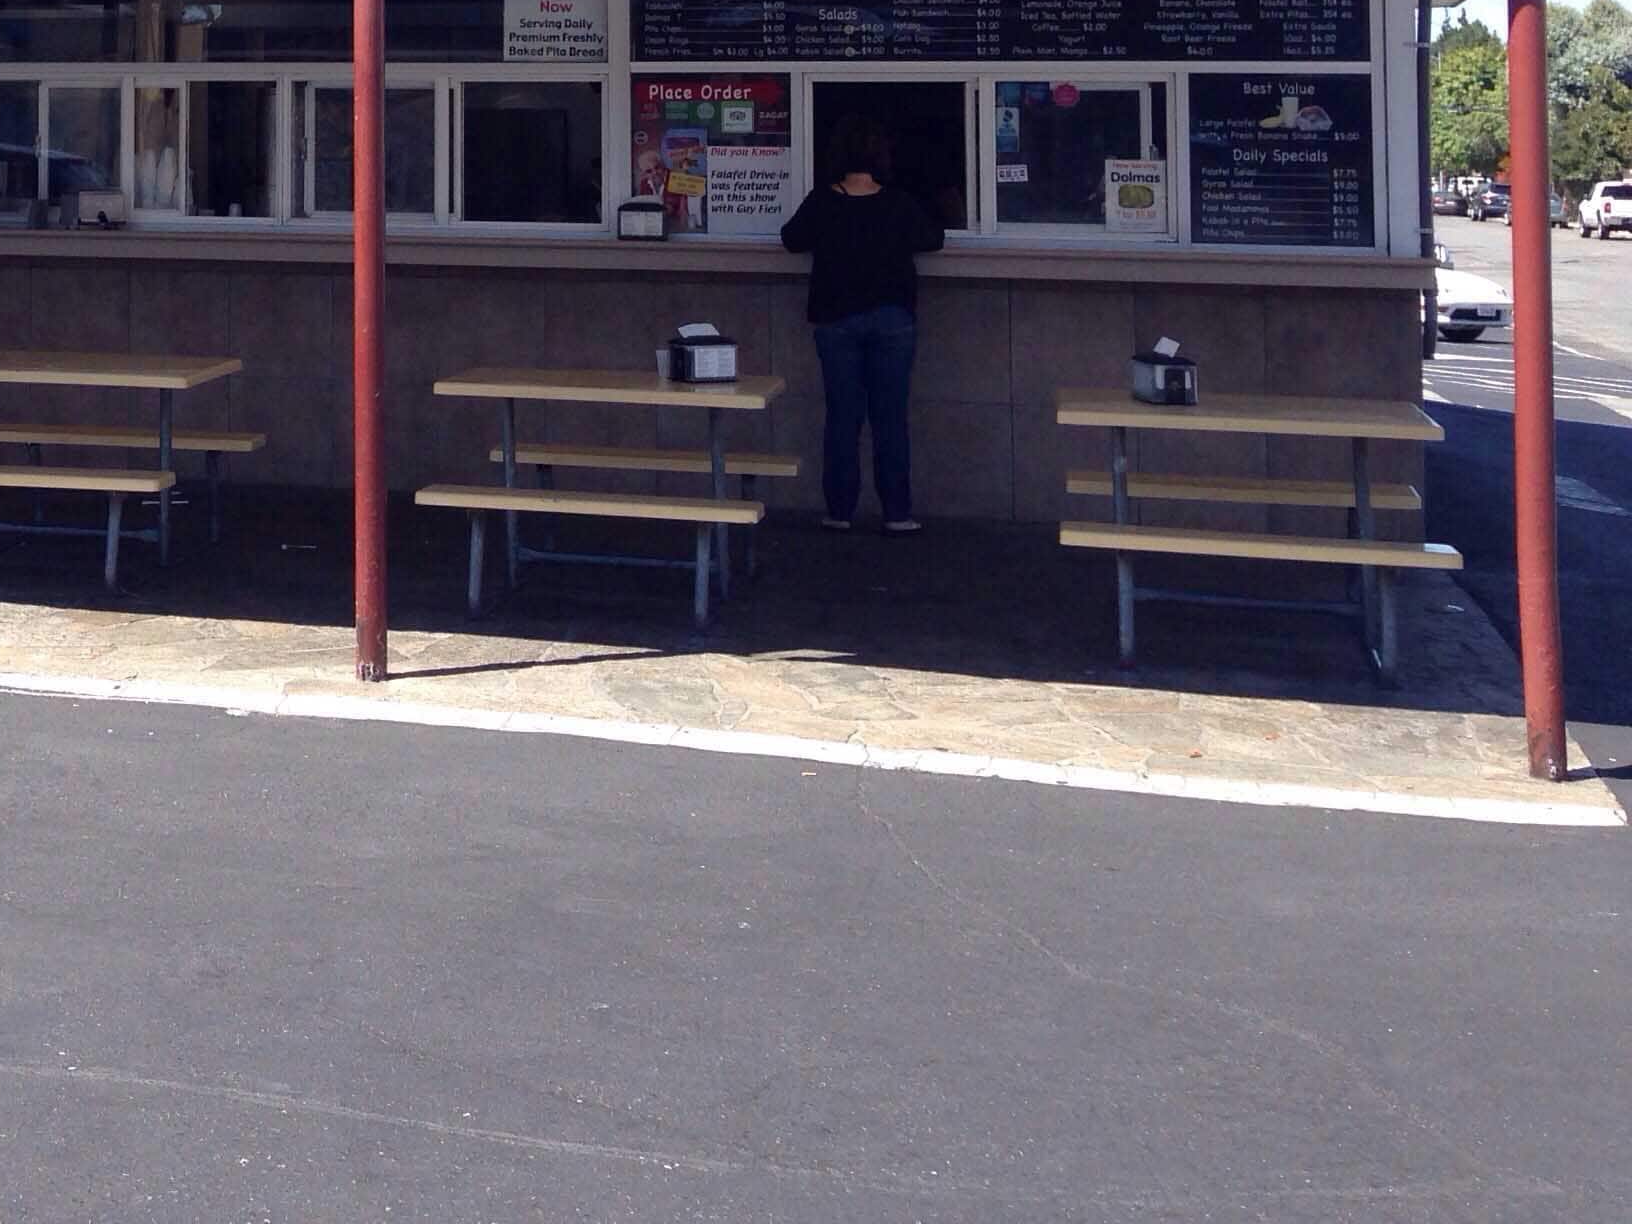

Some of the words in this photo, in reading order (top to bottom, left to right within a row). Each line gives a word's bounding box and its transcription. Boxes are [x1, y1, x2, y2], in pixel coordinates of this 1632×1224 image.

[540, 0, 573, 14] Now
[818, 7, 858, 21] Salads
[519, 18, 562, 31] Serving
[564, 18, 593, 31] Daily
[509, 32, 559, 44] Premium
[562, 32, 604, 46] Freshly
[509, 45, 543, 57] Baked
[546, 45, 567, 57] Pita
[569, 45, 604, 57] Bread
[648, 84, 693, 100] Place
[700, 84, 752, 100] Order
[1243, 81, 1273, 95] Best
[1278, 82, 1316, 96] Value
[711, 147, 728, 156] Did
[730, 148, 749, 158] you
[1233, 148, 1267, 165] Daily
[1272, 148, 1329, 166] Specials
[711, 169, 747, 180] Falafel
[1111, 171, 1161, 183] Dolmas
[711, 182, 731, 191] was
[734, 181, 781, 192] featured
[727, 193, 746, 202] this
[749, 193, 777, 202] show
[711, 204, 734, 214] with
[737, 204, 757, 215] Guy
